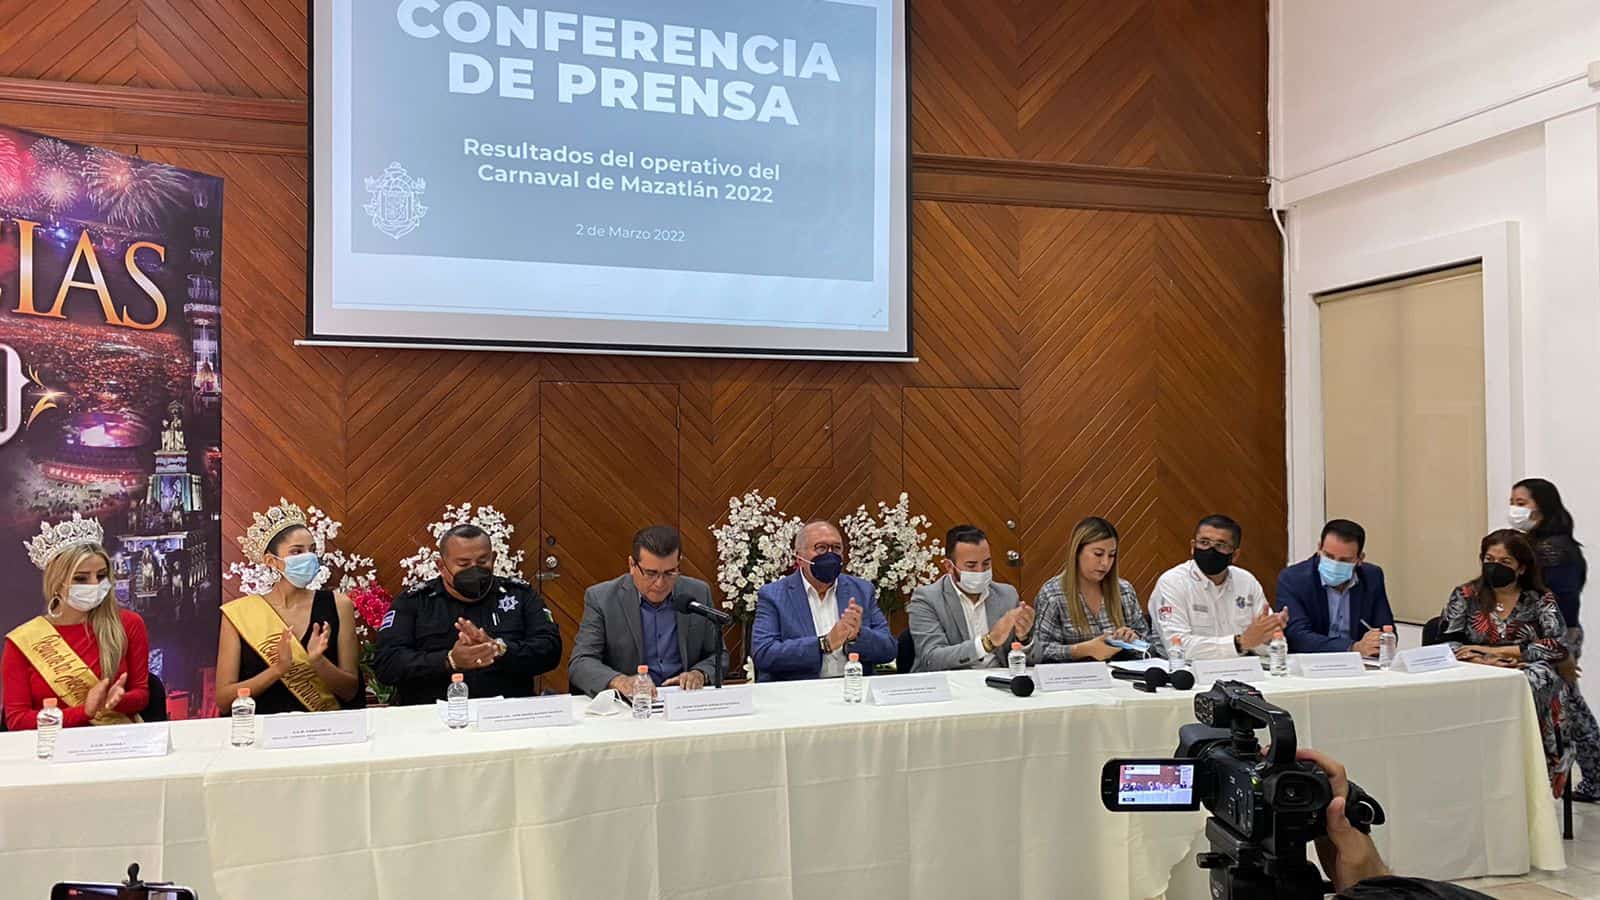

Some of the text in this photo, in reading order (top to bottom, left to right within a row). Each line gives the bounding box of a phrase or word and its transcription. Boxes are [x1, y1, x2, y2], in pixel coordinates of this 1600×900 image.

[396, 0, 841, 82] CONFERENCIA
[449, 52, 800, 126] DE PRENSA
[463, 138, 780, 181] Resultados del operativo del
[478, 164, 774, 203] Carnaval de Mazatlán 2022
[575, 223, 687, 243] 2 de Marzo 2022
[0, 217, 168, 331] IAS
